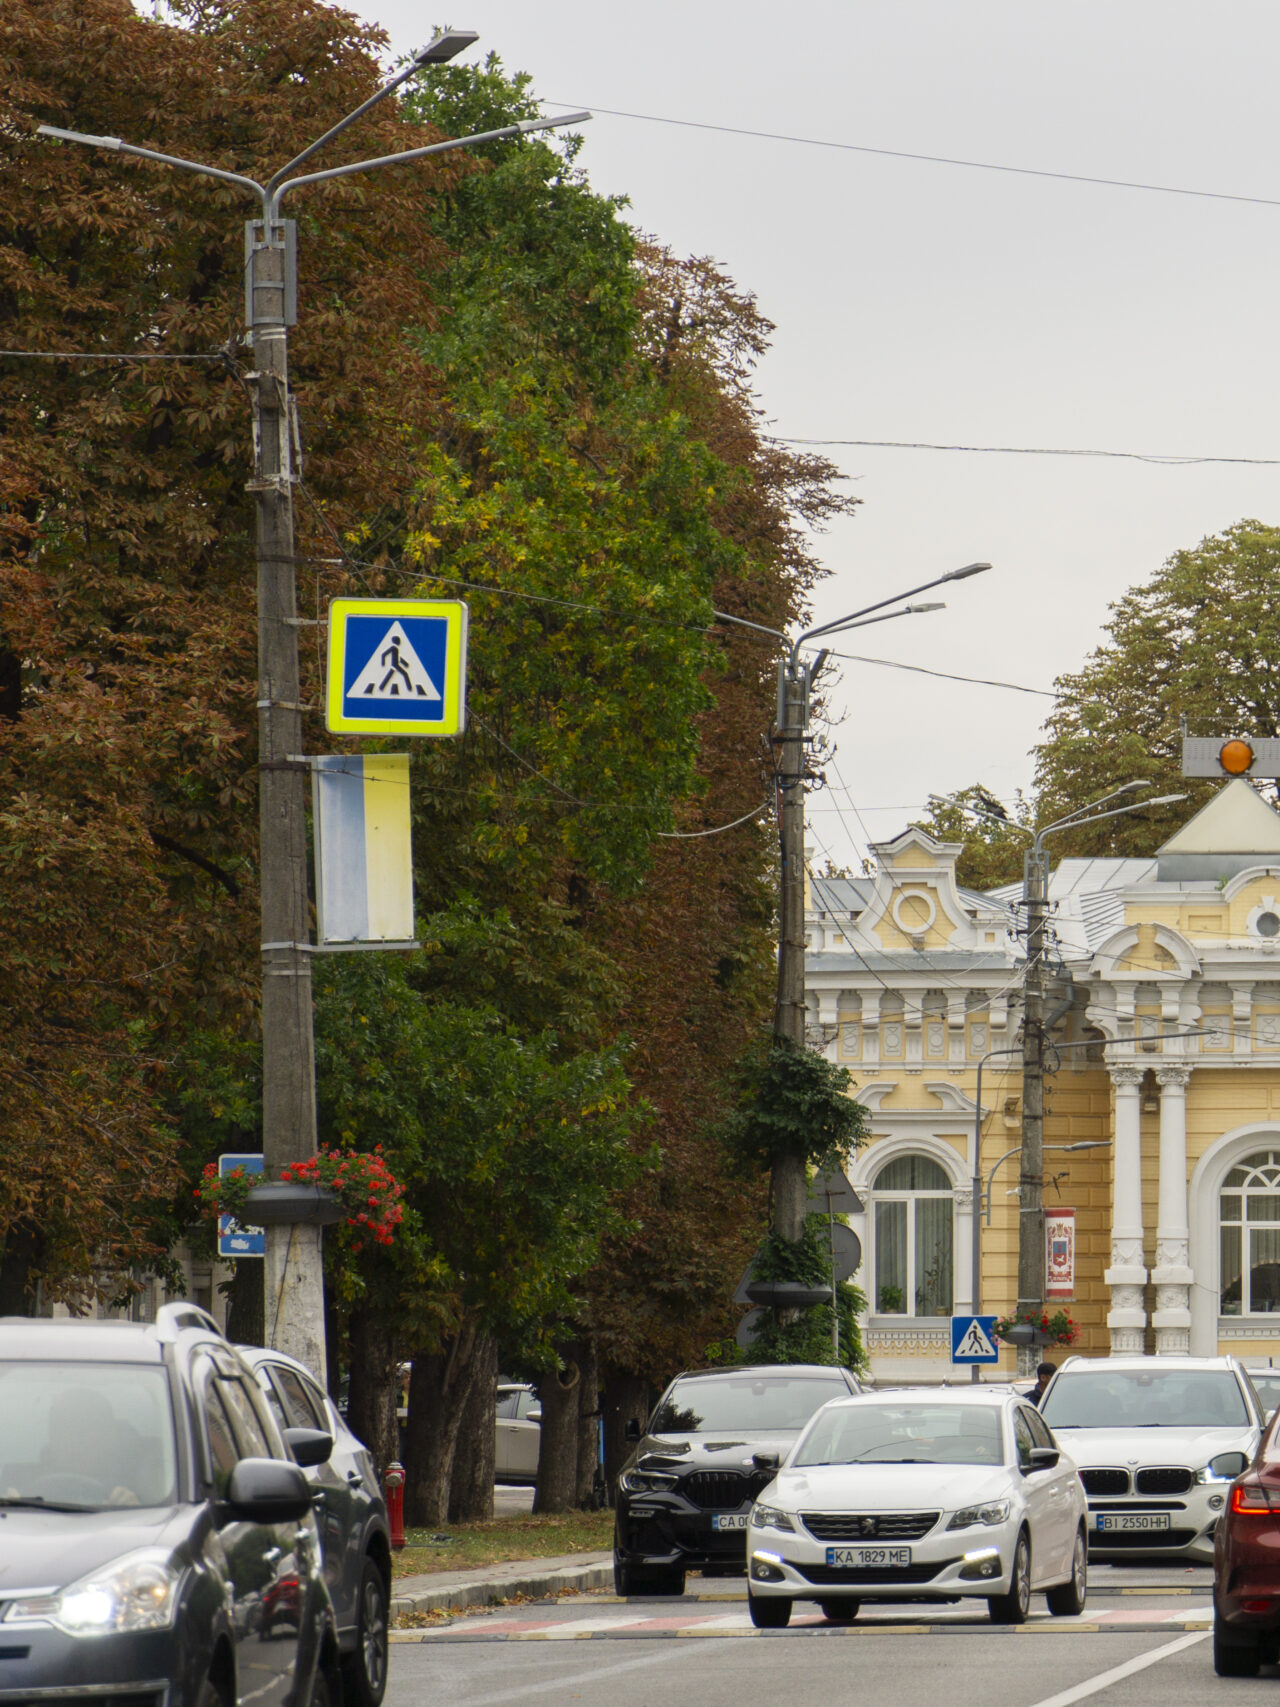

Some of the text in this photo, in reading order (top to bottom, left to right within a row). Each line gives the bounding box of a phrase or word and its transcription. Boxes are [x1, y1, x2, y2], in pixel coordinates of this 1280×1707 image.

[719, 1516, 735, 1527] CA
[1104, 1516, 1167, 1529] BI 2550 HH
[835, 1549, 908, 1563] KA 1829 ME
